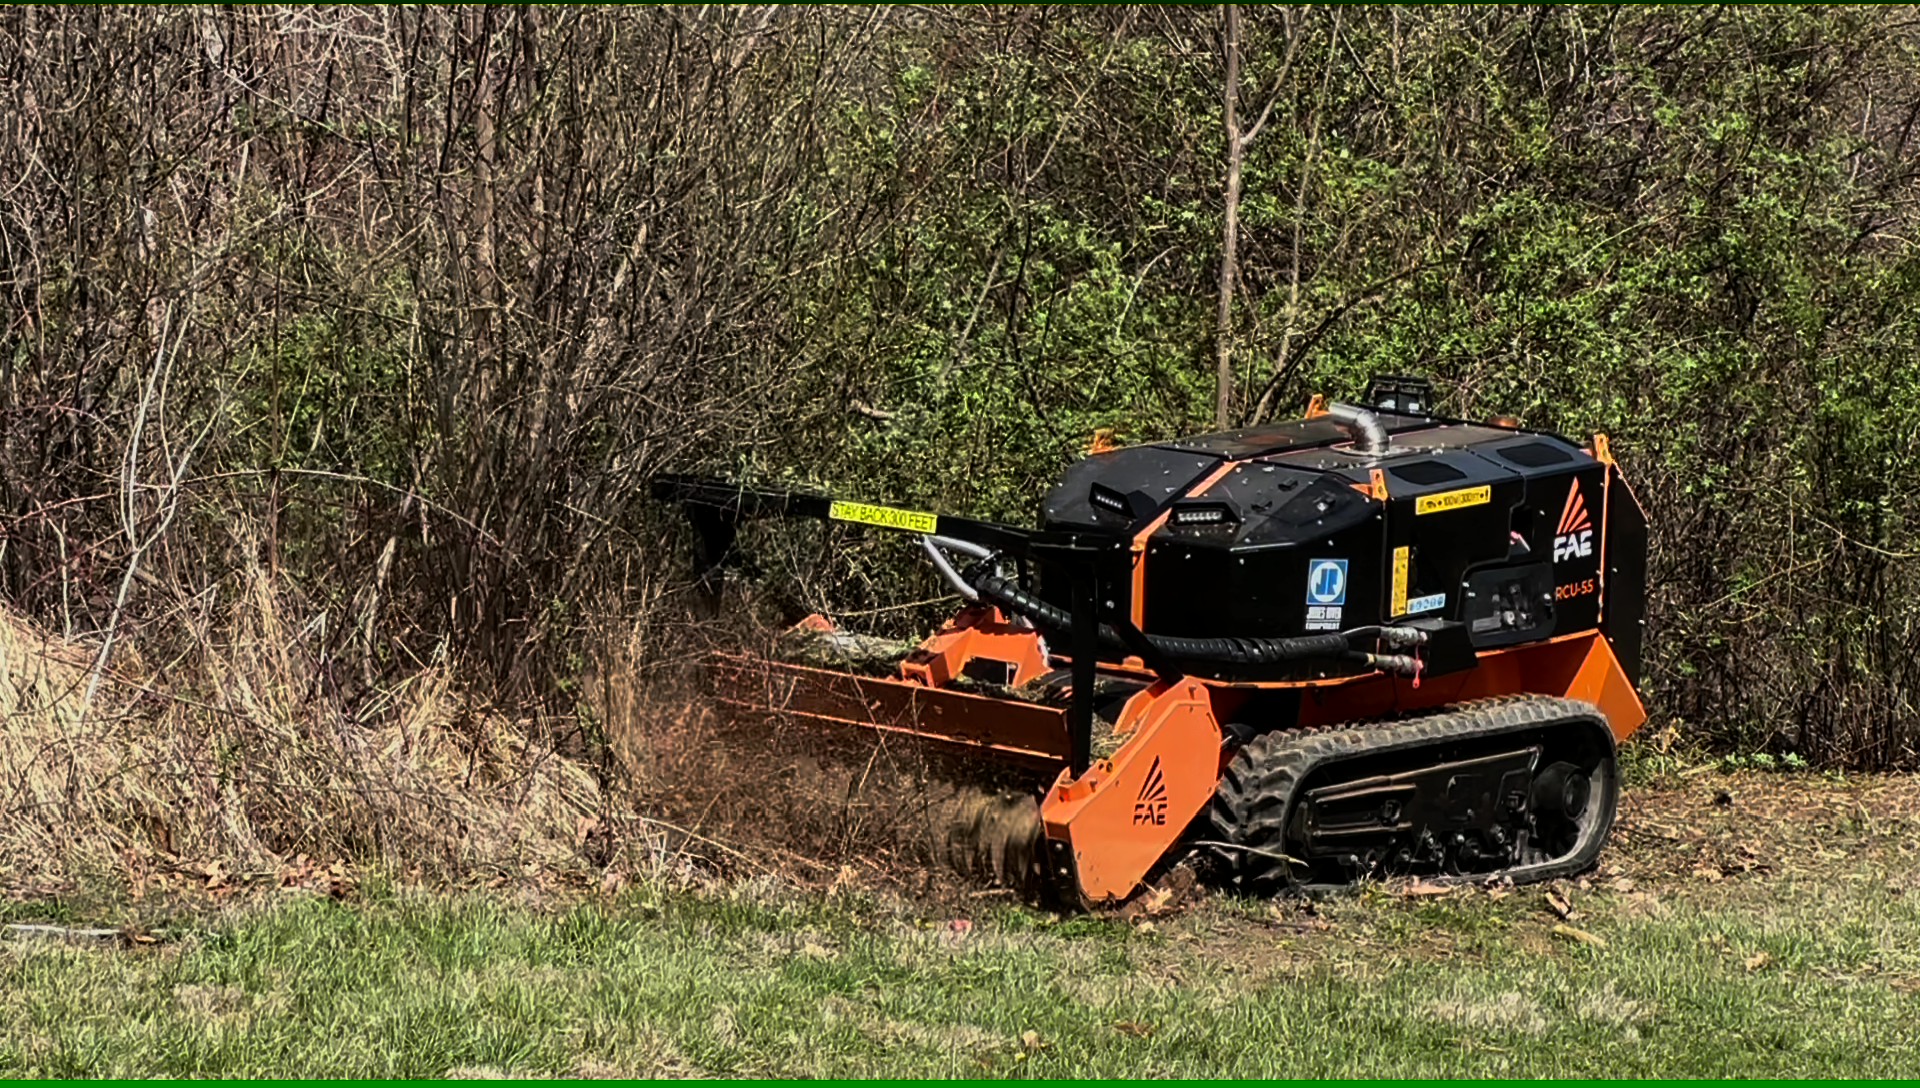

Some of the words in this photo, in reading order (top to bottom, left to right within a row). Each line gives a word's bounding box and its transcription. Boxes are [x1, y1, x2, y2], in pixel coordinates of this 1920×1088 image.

[831, 502, 858, 519] STAY
[859, 507, 889, 524] BACK
[908, 514, 936, 531] FEET
[1554, 530, 1592, 563] FAE
[1555, 579, 1593, 601] RCU-55
[1133, 803, 1167, 826] FAE
